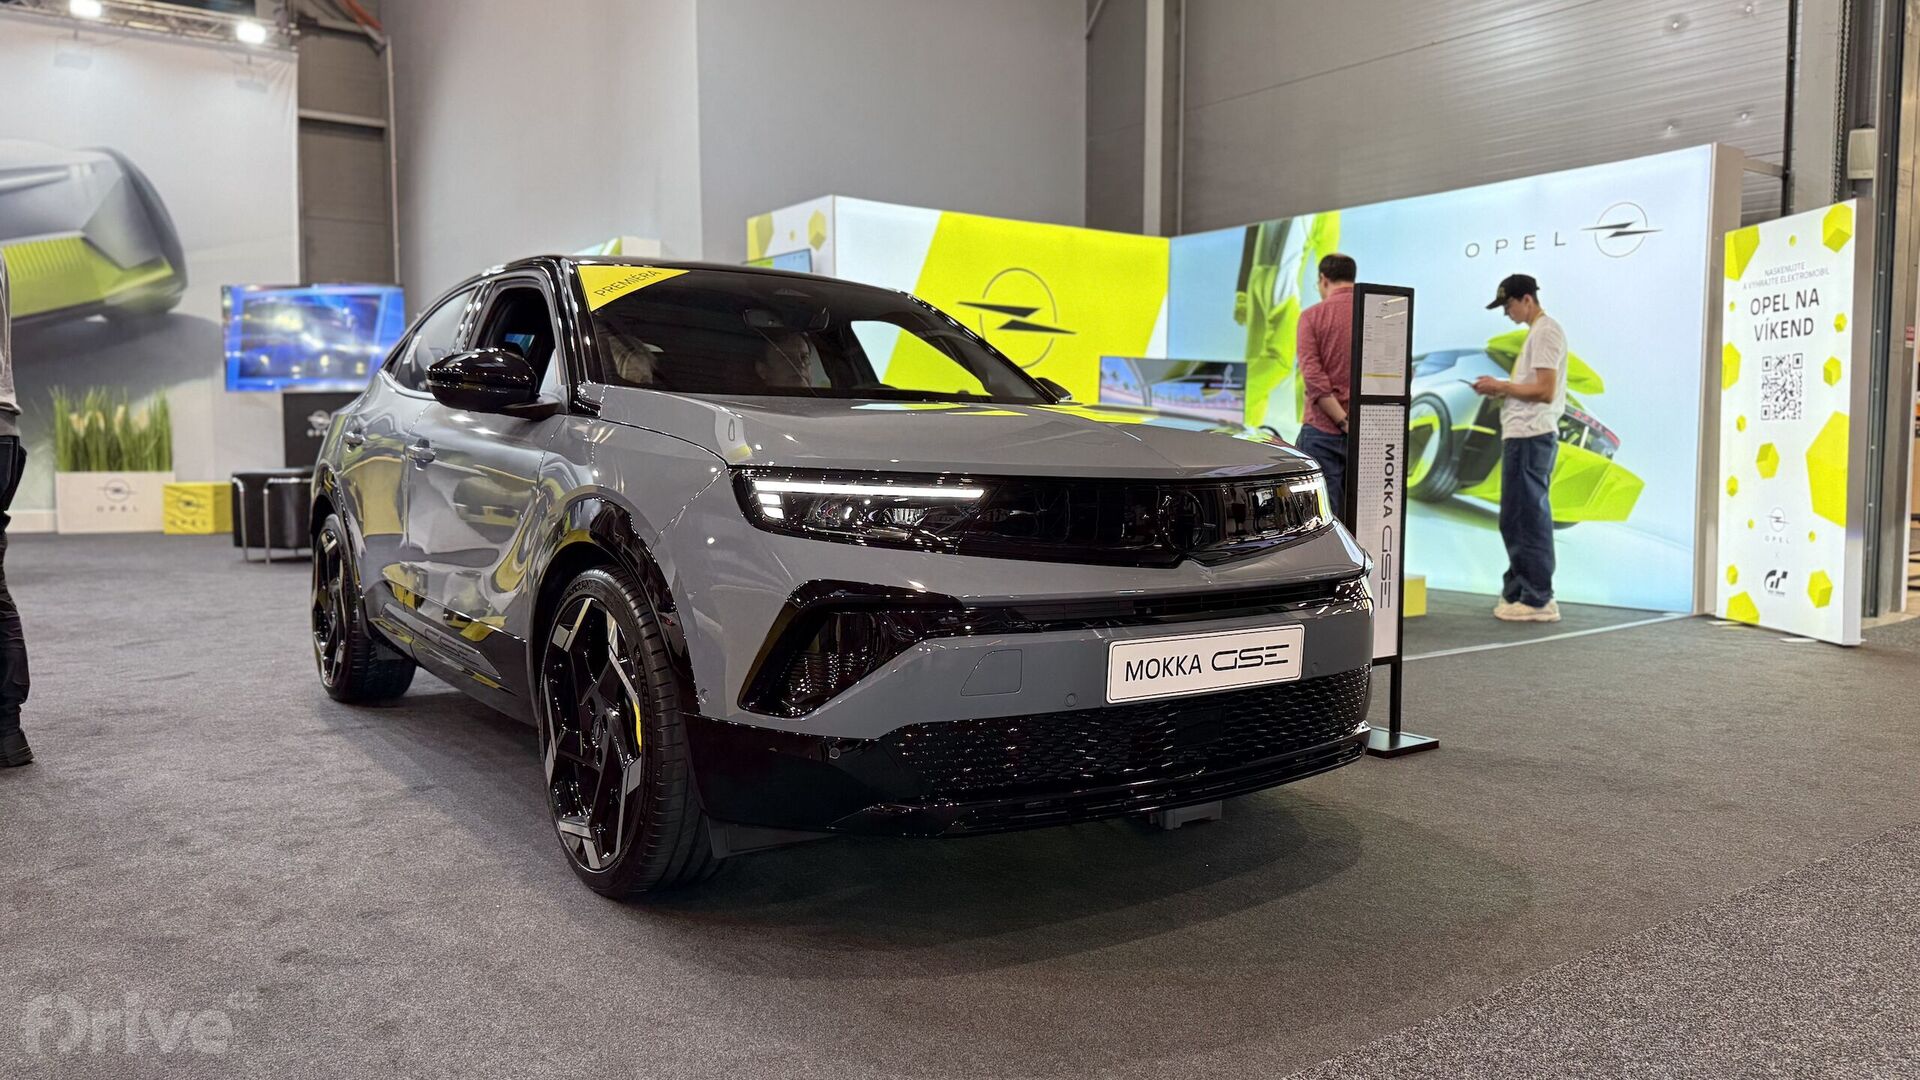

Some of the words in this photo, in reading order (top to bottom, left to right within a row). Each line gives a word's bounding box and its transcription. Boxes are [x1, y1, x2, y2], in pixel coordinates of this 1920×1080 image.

[1464, 231, 1567, 258] OPEL
[1750, 294, 1790, 316] OPEL
[1795, 287, 1820, 310] NA
[1754, 316, 1815, 342] VÍKEND
[1383, 444, 1396, 518] MOKKA
[1379, 525, 1393, 609] GSE
[1124, 654, 1202, 682] MOKKA
[1211, 643, 1290, 671] GSE
